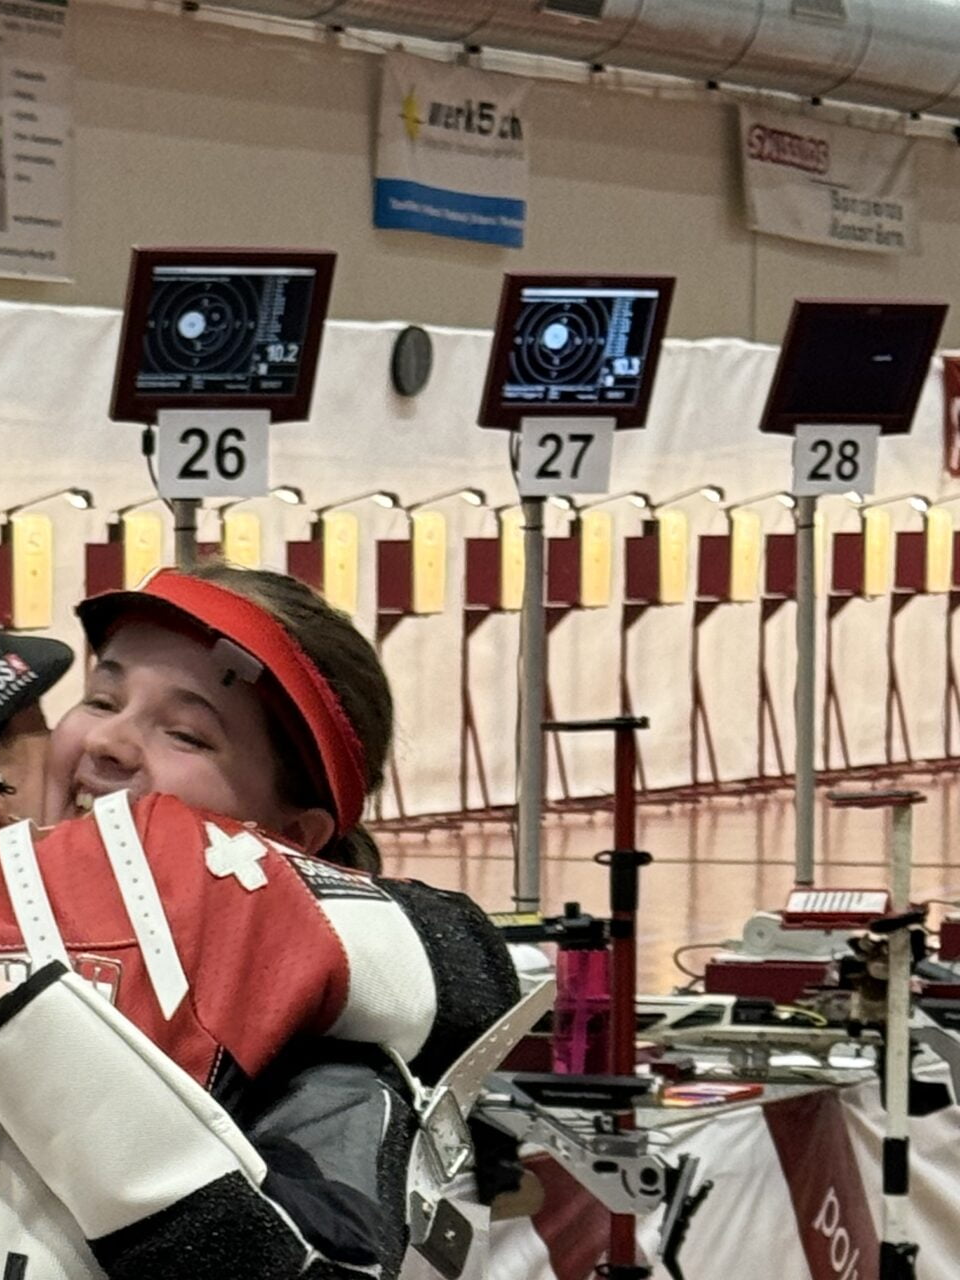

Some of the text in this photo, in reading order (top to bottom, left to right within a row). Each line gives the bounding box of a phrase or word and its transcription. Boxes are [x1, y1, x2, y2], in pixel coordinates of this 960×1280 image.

[177, 427, 246, 481] 26
[535, 433, 595, 480] 27
[807, 439, 859, 482] 28
